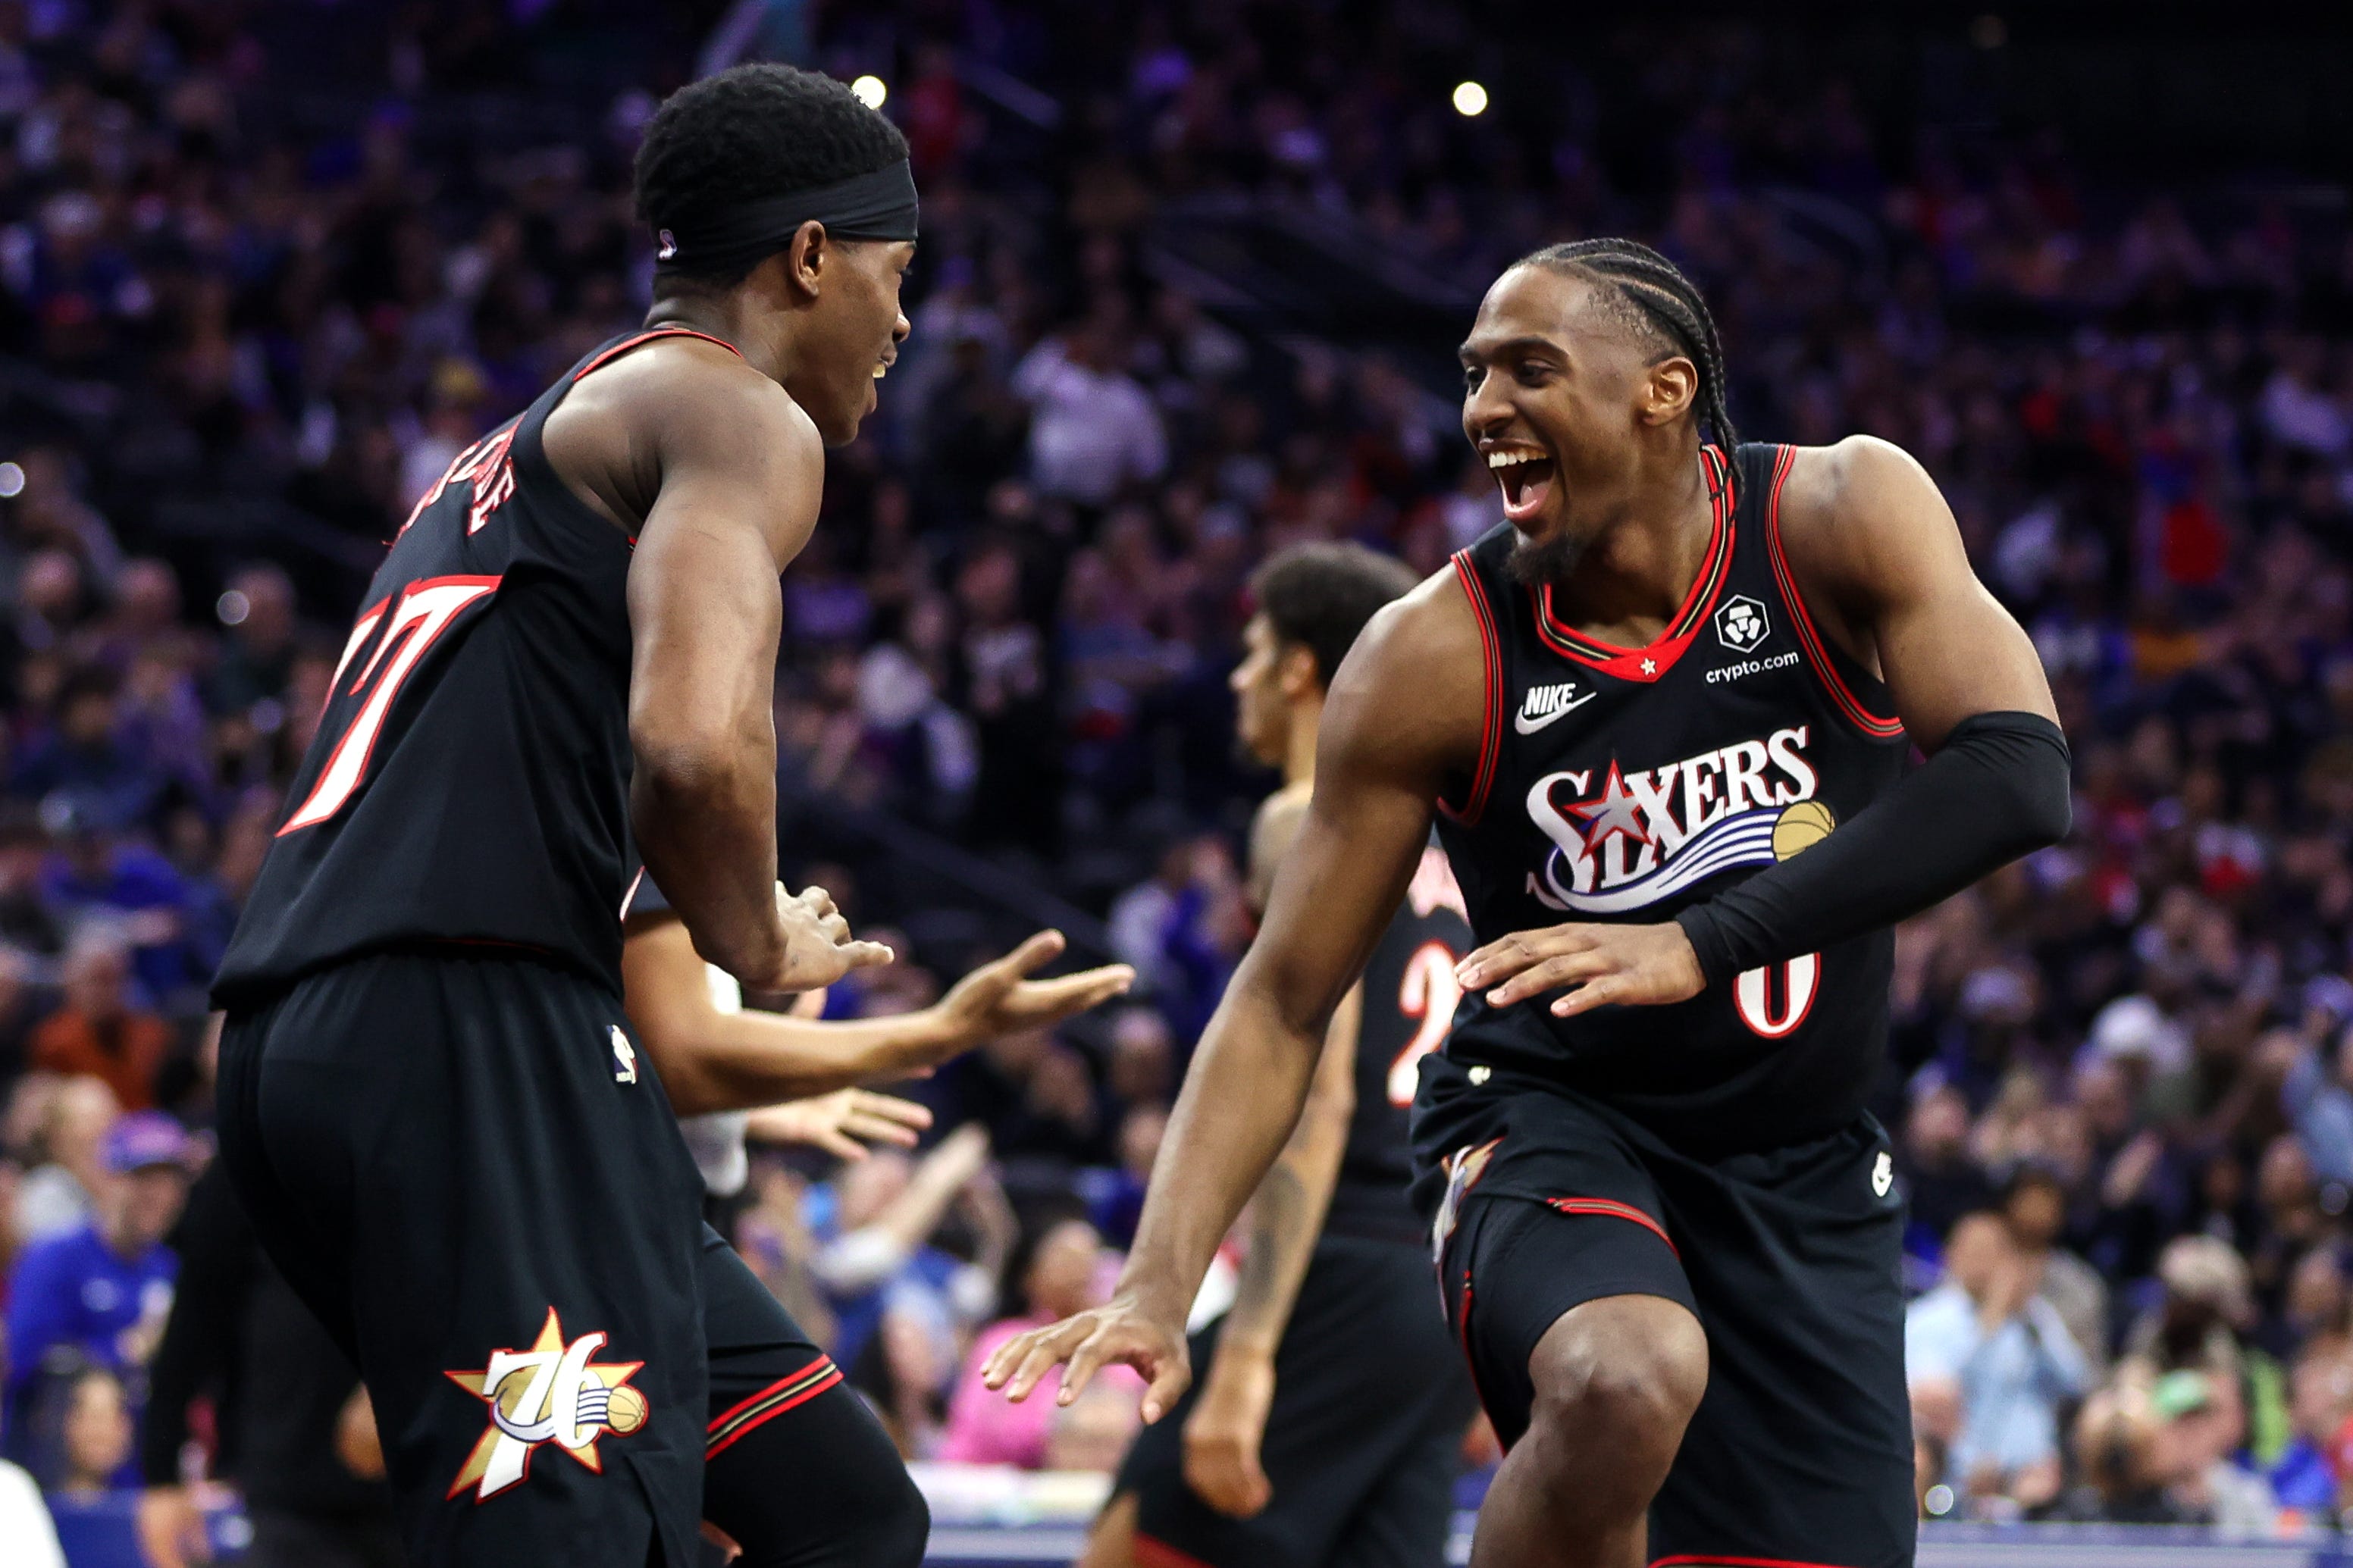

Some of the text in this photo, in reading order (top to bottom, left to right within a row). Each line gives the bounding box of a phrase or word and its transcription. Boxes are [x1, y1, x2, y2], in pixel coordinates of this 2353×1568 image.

[1706, 651, 1800, 684] crypto.com
[1524, 682, 1576, 716] NIKE
[478, 1332, 606, 1504] 76
